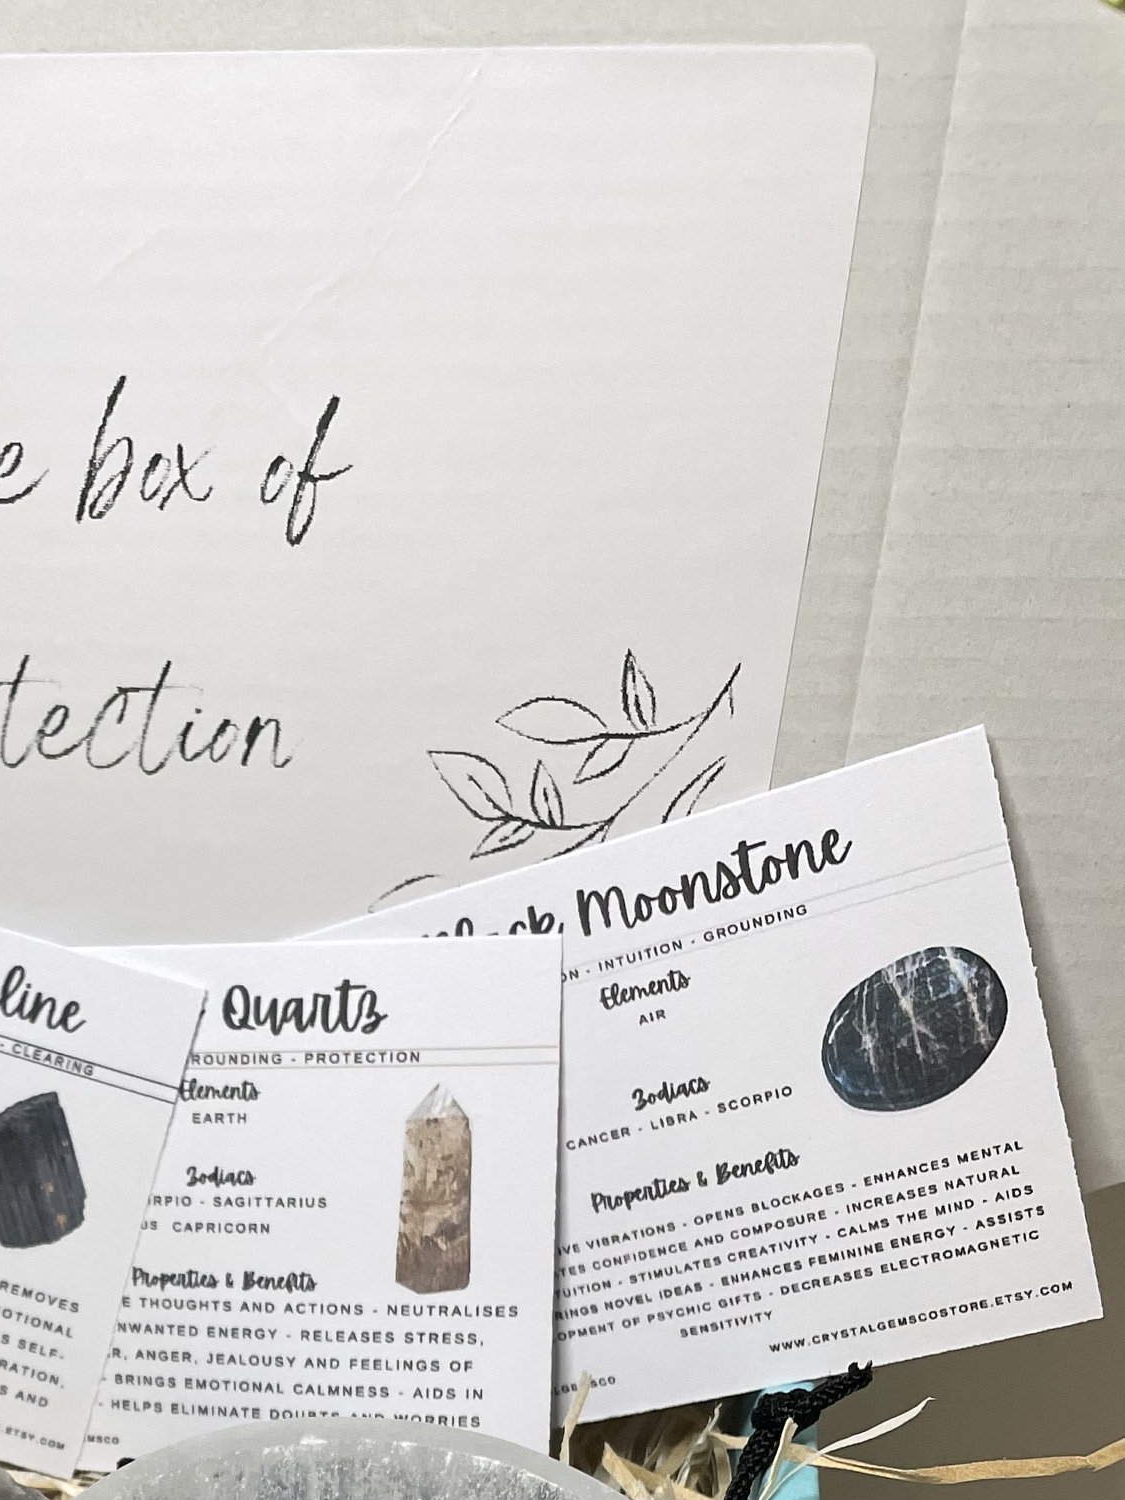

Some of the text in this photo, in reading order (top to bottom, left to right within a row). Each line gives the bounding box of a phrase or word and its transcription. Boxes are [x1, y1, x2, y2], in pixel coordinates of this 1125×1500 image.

[75, 375, 218, 523] box
[260, 394, 353, 546] of
[576, 828, 852, 936] Moonstone
[598, 904, 807, 972] INTUITION GROUNDING
[600, 970, 691, 1010] Elements
[222, 979, 387, 1036] Quartz
[639, 1009, 666, 1025] AIR
[11, 1043, 95, 1076] CLEARING
[303, 1050, 422, 1062] PROTECTION
[179, 1078, 260, 1101] Elements
[192, 1112, 247, 1124] EARTH
[564, 1085, 792, 1153] CANCER LIBRA SCORPIO
[585, 1141, 1024, 1250] VIBRATIONS OPENS BLOCKAGES ENHANCES MENTAL
[591, 1148, 800, 1213] Properties & Benefits
[213, 1195, 327, 1209] SAGITTARIUS
[172, 1220, 270, 1235] CAPRICORN
[592, 1163, 1020, 1272] CONFIDENCE AND COMPOSURE INCREASES NATURAL
[629, 1256, 722, 1285] STIMULATES
[727, 1232, 819, 1264] CREATIVITY
[836, 1215, 892, 1240] CALMS
[895, 1207, 930, 1227] THE
[932, 1196, 977, 1217] MIND
[992, 1185, 1034, 1205] AIDS
[604, 1292, 652, 1311] NOVEL
[659, 1281, 703, 1301] IDEAS
[721, 1259, 803, 1287] ENHANCES
[806, 1240, 886, 1269] FEMININE
[890, 1225, 955, 1251] ENERGY
[972, 1205, 1045, 1231] ASSISTS
[132, 1266, 317, 1293] Properties & Benefits
[621, 1229, 1040, 1329] OF PSYCHIC GIFTS DECREASES ELECTROMAGNETIC
[139, 1296, 518, 1318] THOUGHTS AND ACTIONS NEUTRALISES
[206, 1325, 277, 1340] ENERGY
[300, 1328, 395, 1344] RELEASES
[680, 1309, 774, 1339] SENSITIVITY
[206, 1352, 296, 1368] JEALOUSY
[304, 1357, 340, 1370] AND
[349, 1357, 440, 1372] FEELINGS
[449, 1360, 473, 1373] OF
[15, 1390, 49, 1408] AND
[114, 1373, 483, 1400] BRINGS EMOTIONAL CALMNESS AIDS IN
[111, 1398, 164, 1414] HELPS
[171, 1402, 261, 1419] ELIMINATE
